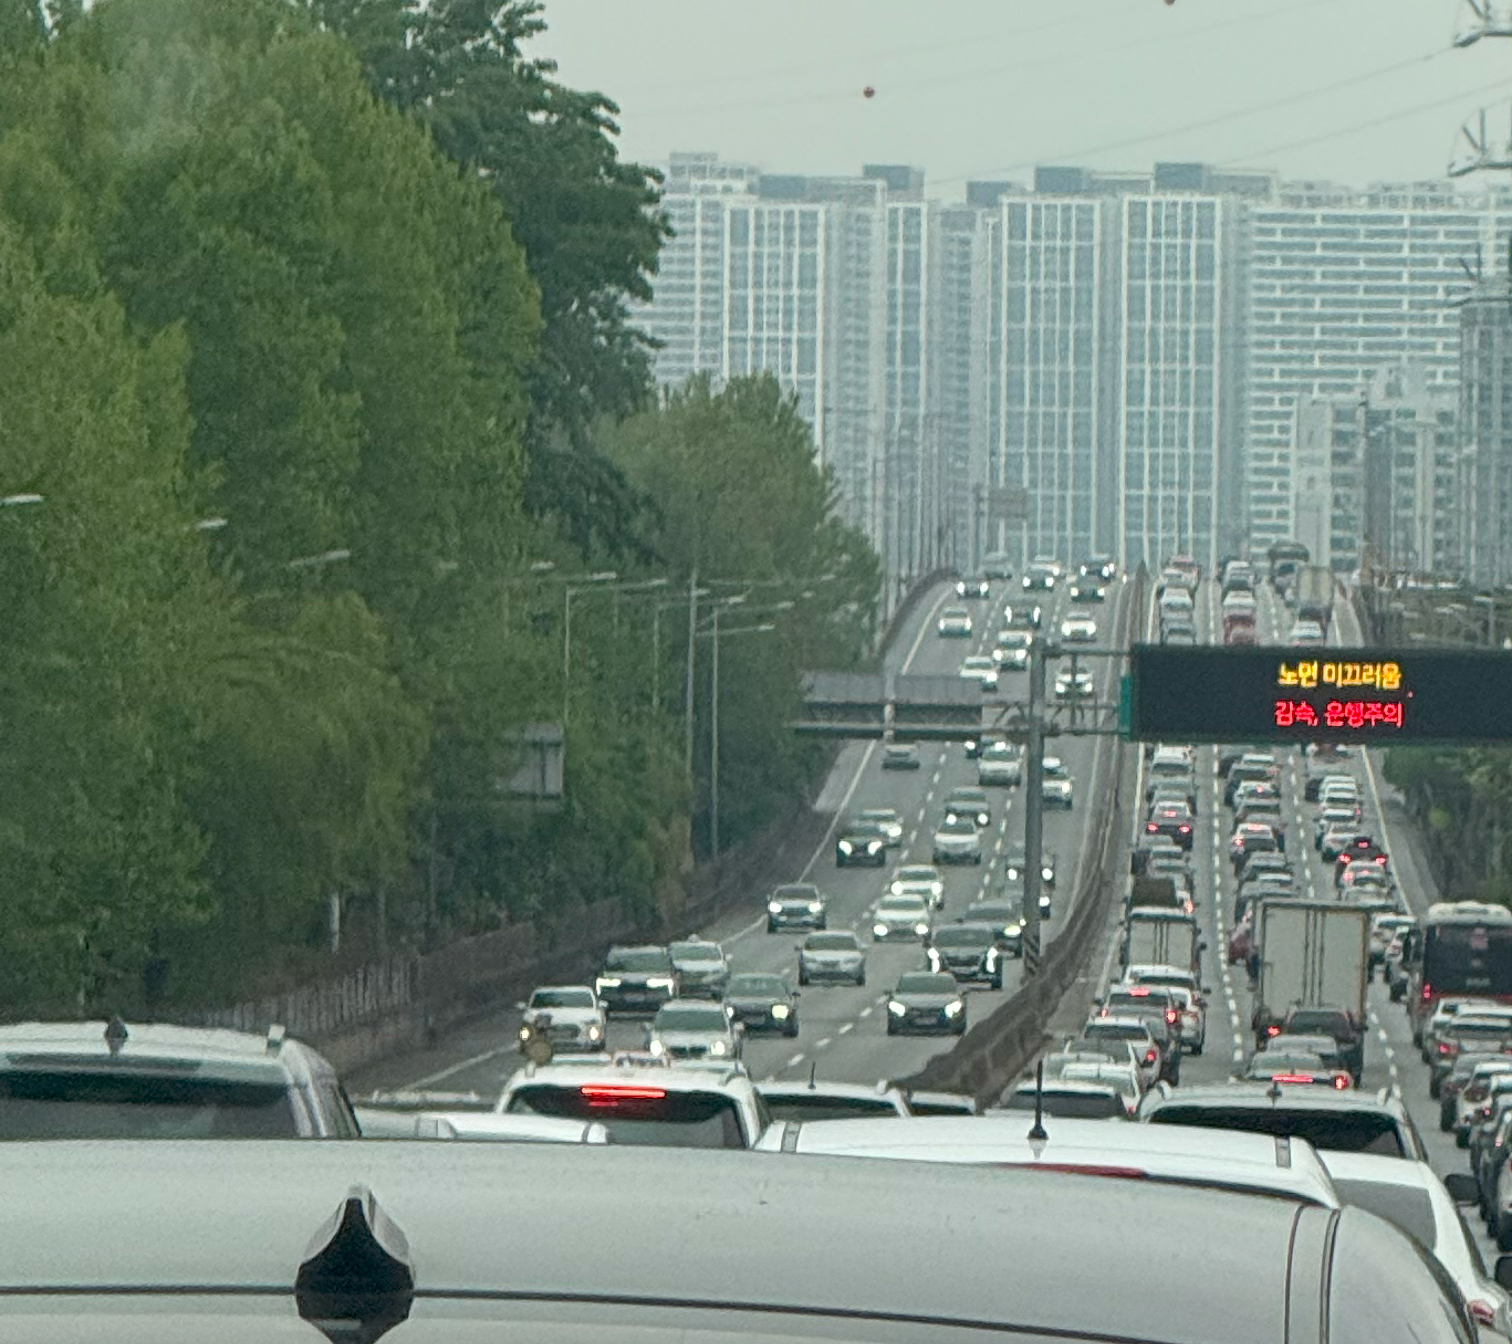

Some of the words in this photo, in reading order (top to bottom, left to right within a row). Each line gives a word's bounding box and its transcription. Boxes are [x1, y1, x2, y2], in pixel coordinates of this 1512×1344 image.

[1278, 660, 1318, 688] 노면
[1322, 661, 1402, 689] 미끄러움
[1274, 700, 1319, 727] 감속,
[1325, 700, 1403, 728] 운행주의
